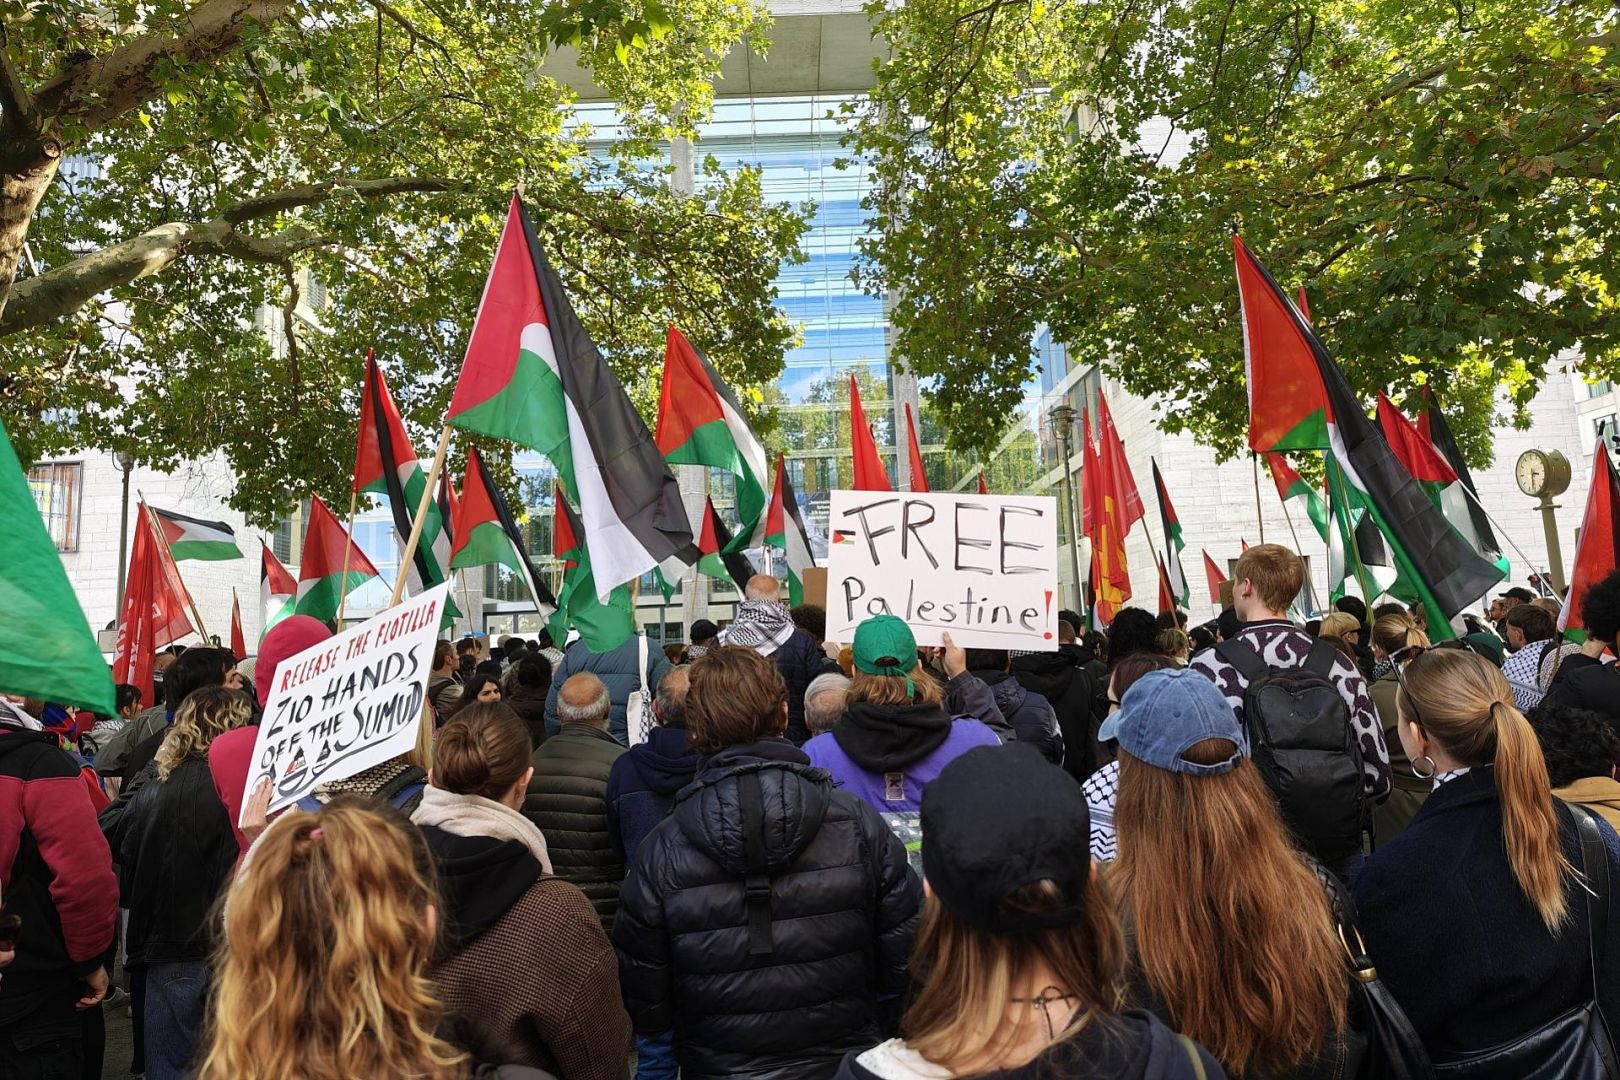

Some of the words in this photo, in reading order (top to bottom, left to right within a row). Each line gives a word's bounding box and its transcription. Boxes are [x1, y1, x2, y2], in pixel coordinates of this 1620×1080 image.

[843, 499, 1049, 575] FREE
[280, 645, 341, 693] RELEASE
[346, 630, 371, 661] THE
[375, 600, 436, 649] FLOTILLA
[842, 576, 1053, 640] Palestine!
[261, 729, 302, 770] OFF
[308, 711, 346, 743] THE
[333, 680, 424, 752] SUMUD
[267, 695, 313, 739] ZIO
[322, 642, 423, 712] HANDS
